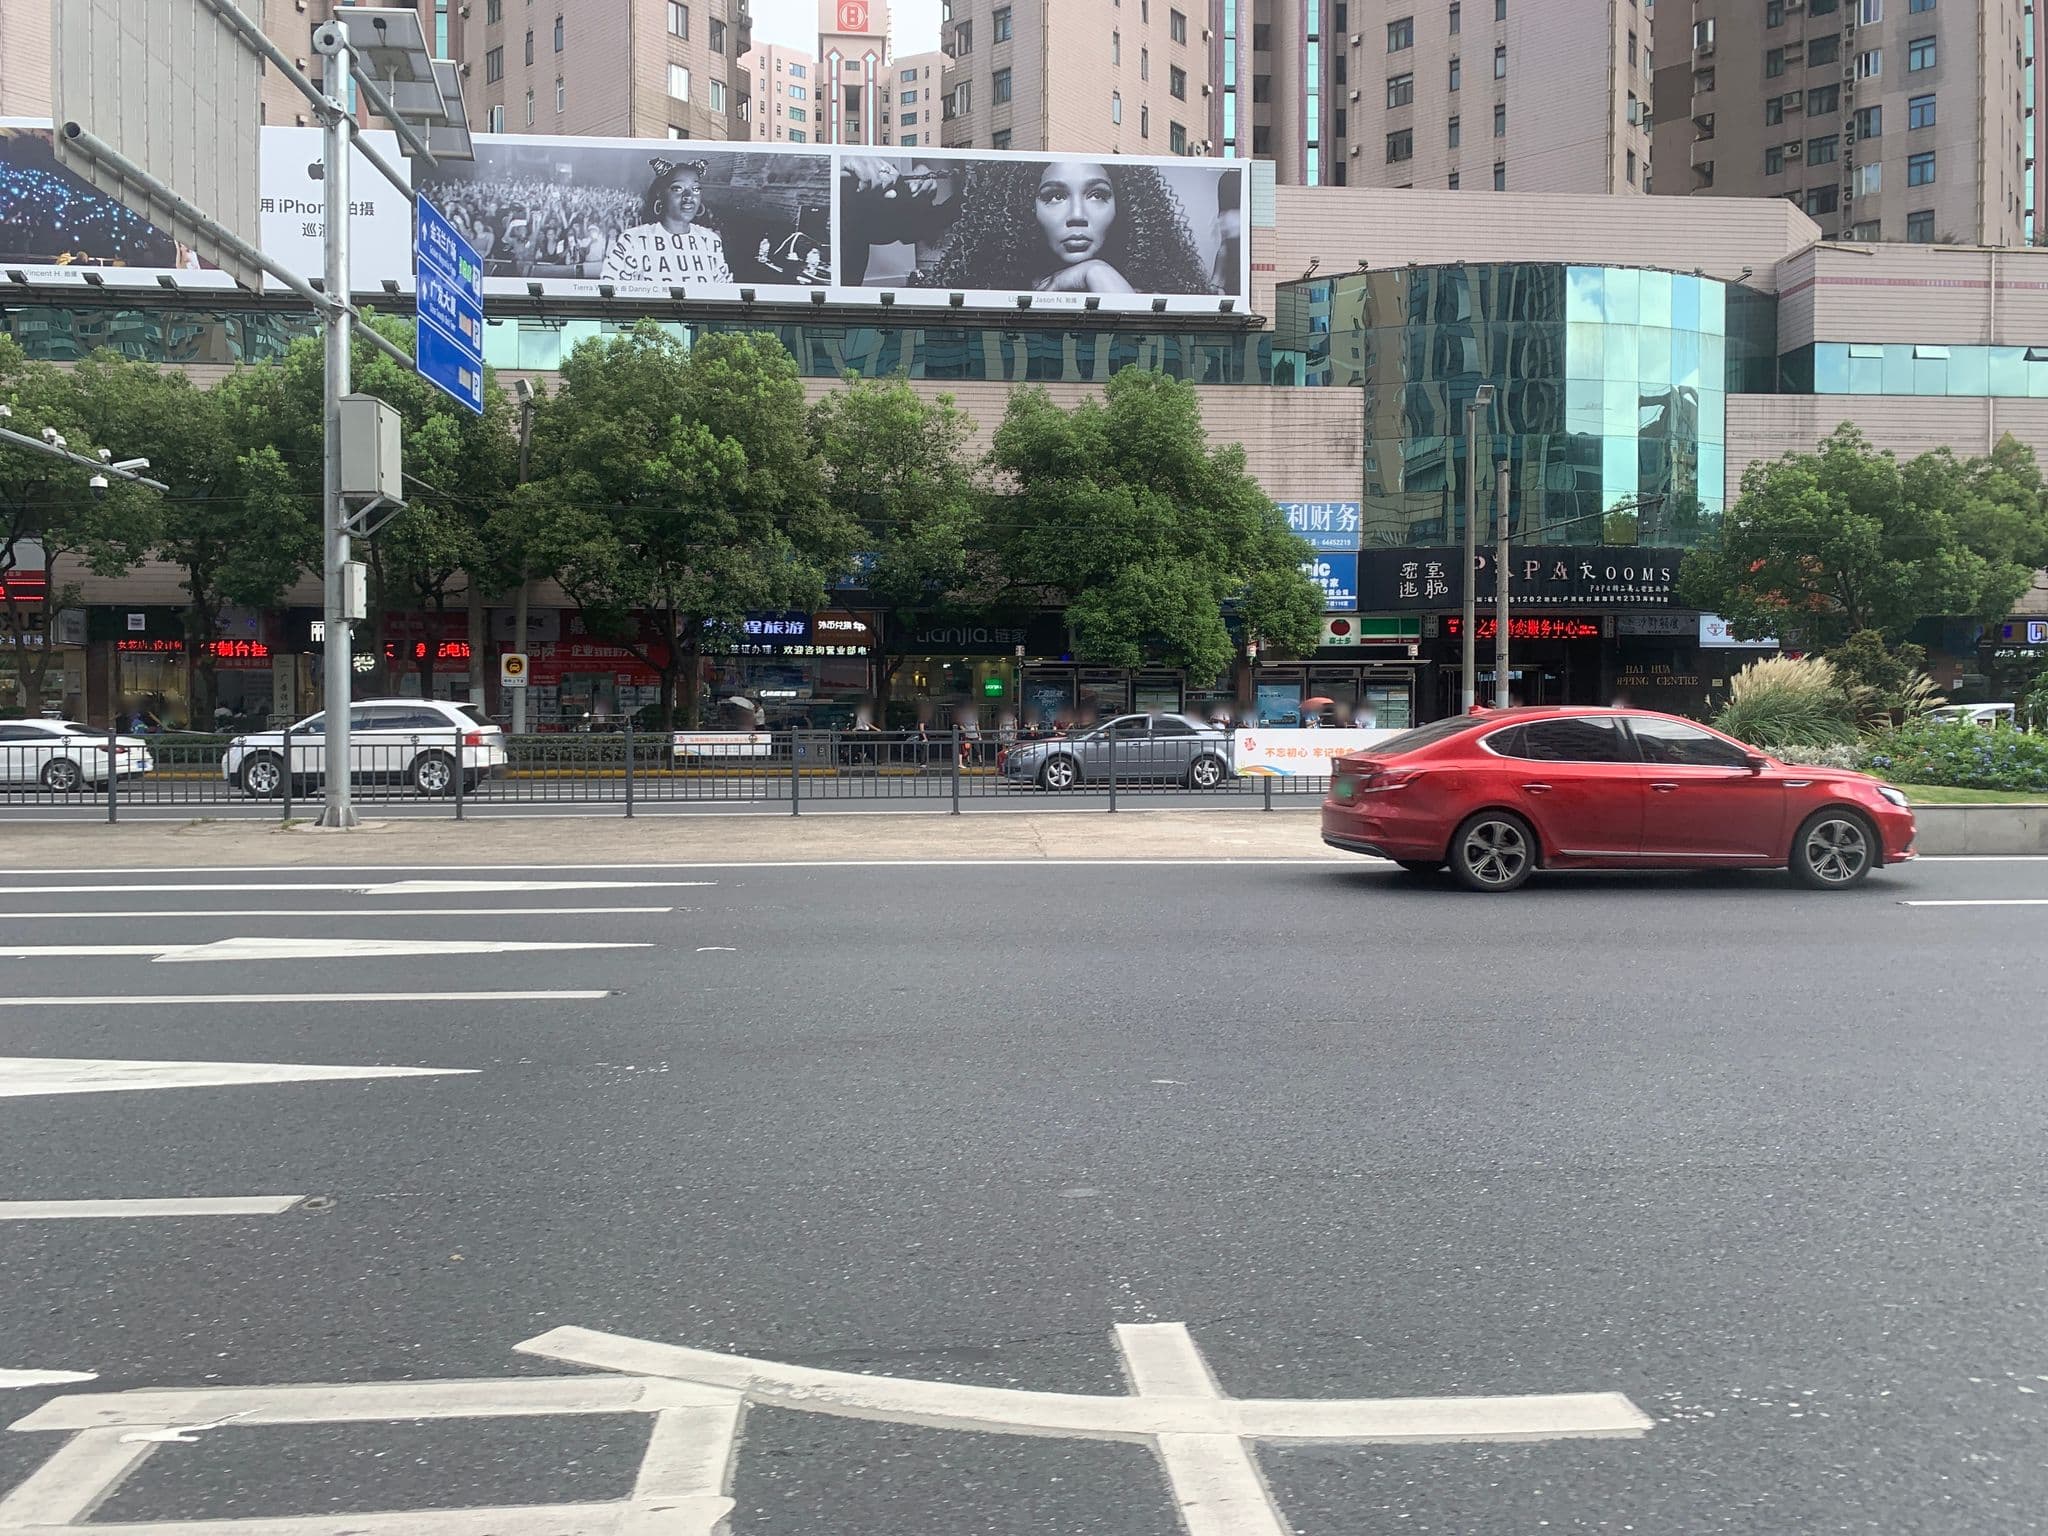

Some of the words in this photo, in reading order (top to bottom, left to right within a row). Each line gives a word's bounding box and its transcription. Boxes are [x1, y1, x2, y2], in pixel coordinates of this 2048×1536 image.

[1280, 503, 1359, 532] 利财务
[1400, 561, 1445, 579] 密室
[1400, 580, 1449, 599] 逃脱
[1265, 748, 1308, 758] 不忘初心
